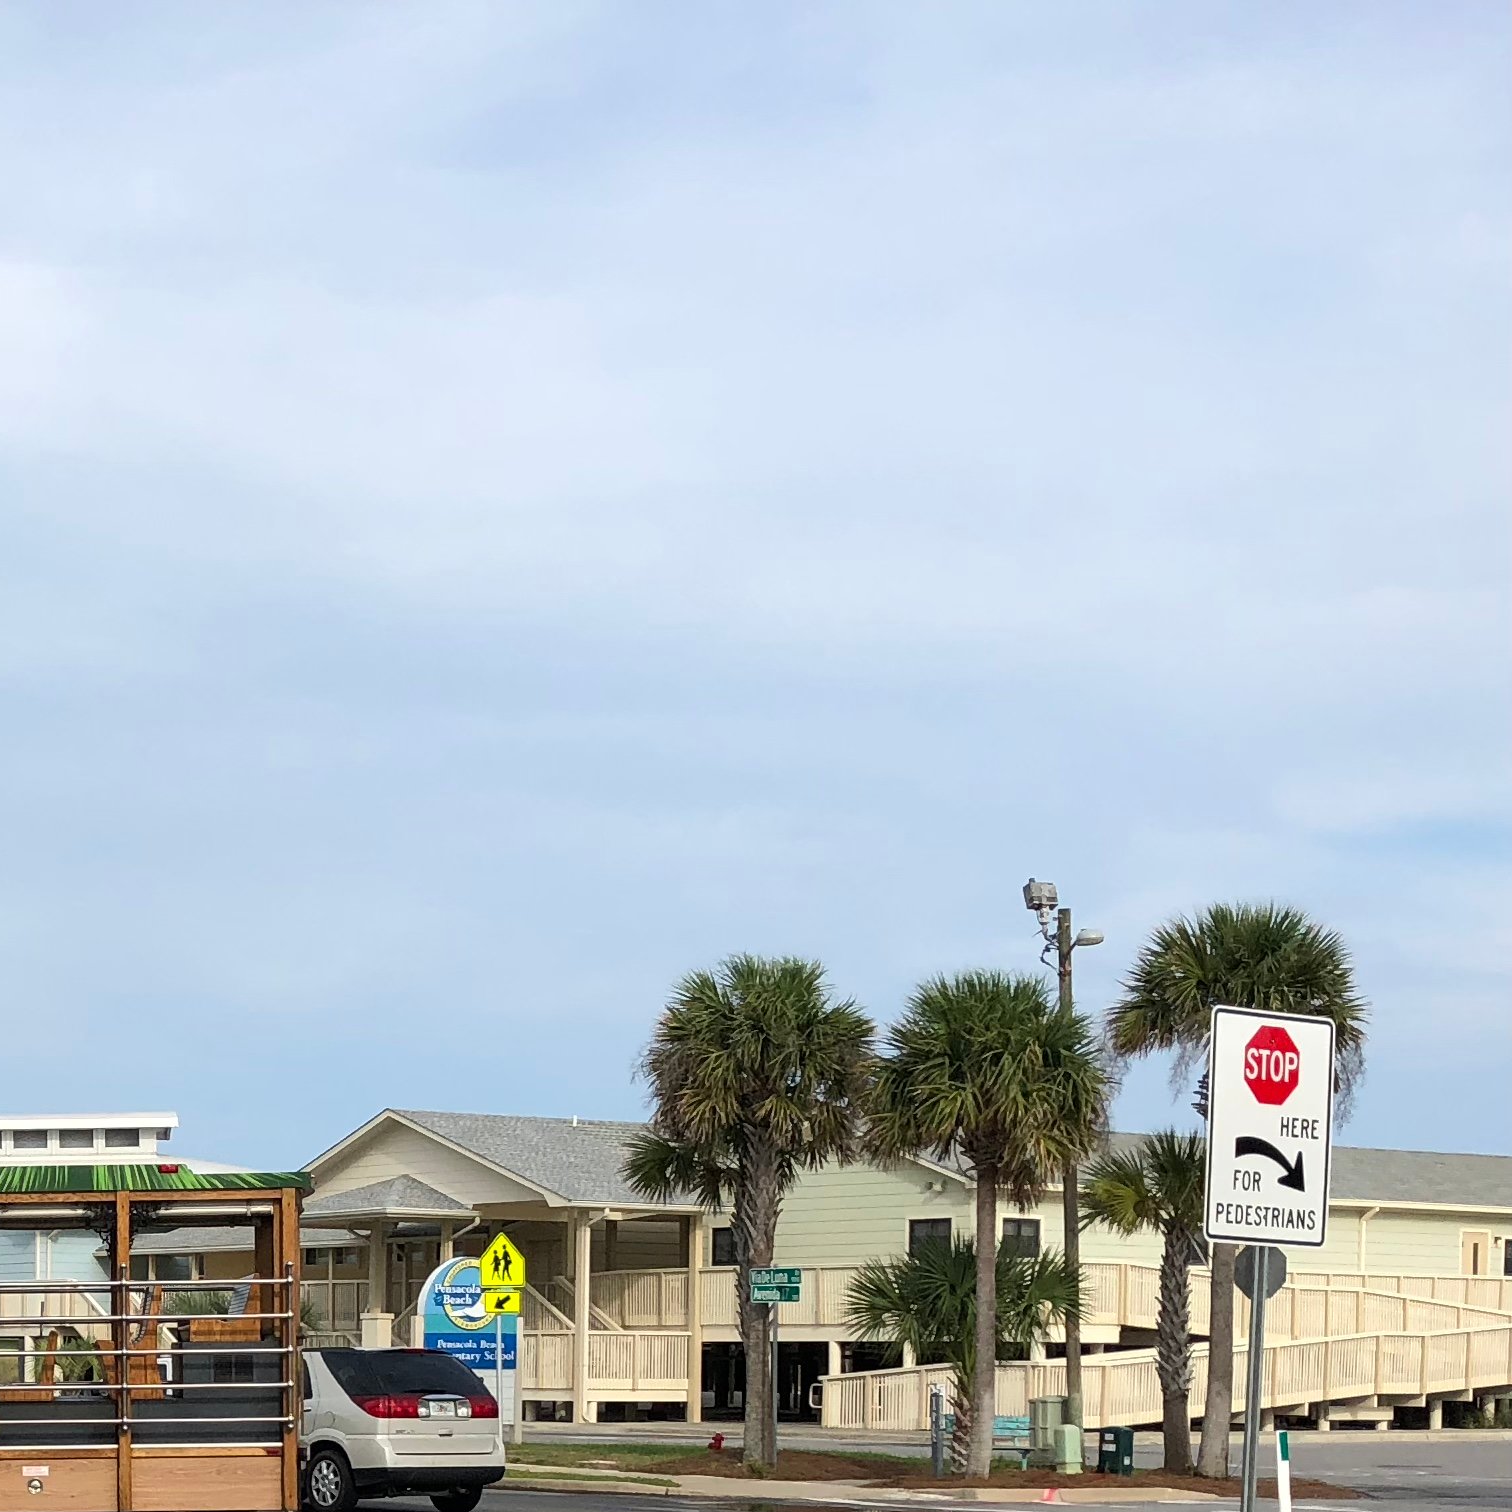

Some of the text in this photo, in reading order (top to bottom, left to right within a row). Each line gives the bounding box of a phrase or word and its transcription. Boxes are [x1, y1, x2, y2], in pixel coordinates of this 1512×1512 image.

[1245, 1048, 1298, 1083] STOP
[1280, 1116, 1319, 1140] HERE
[1232, 1169, 1261, 1192] FOR
[1216, 1202, 1316, 1231] PEDESTRIANS
[771, 1271, 788, 1283] Luna
[434, 1283, 481, 1294] Pensacola
[753, 1287, 780, 1300] Avenida
[443, 1294, 473, 1305] Beach
[437, 1339, 478, 1349] Pensacola
